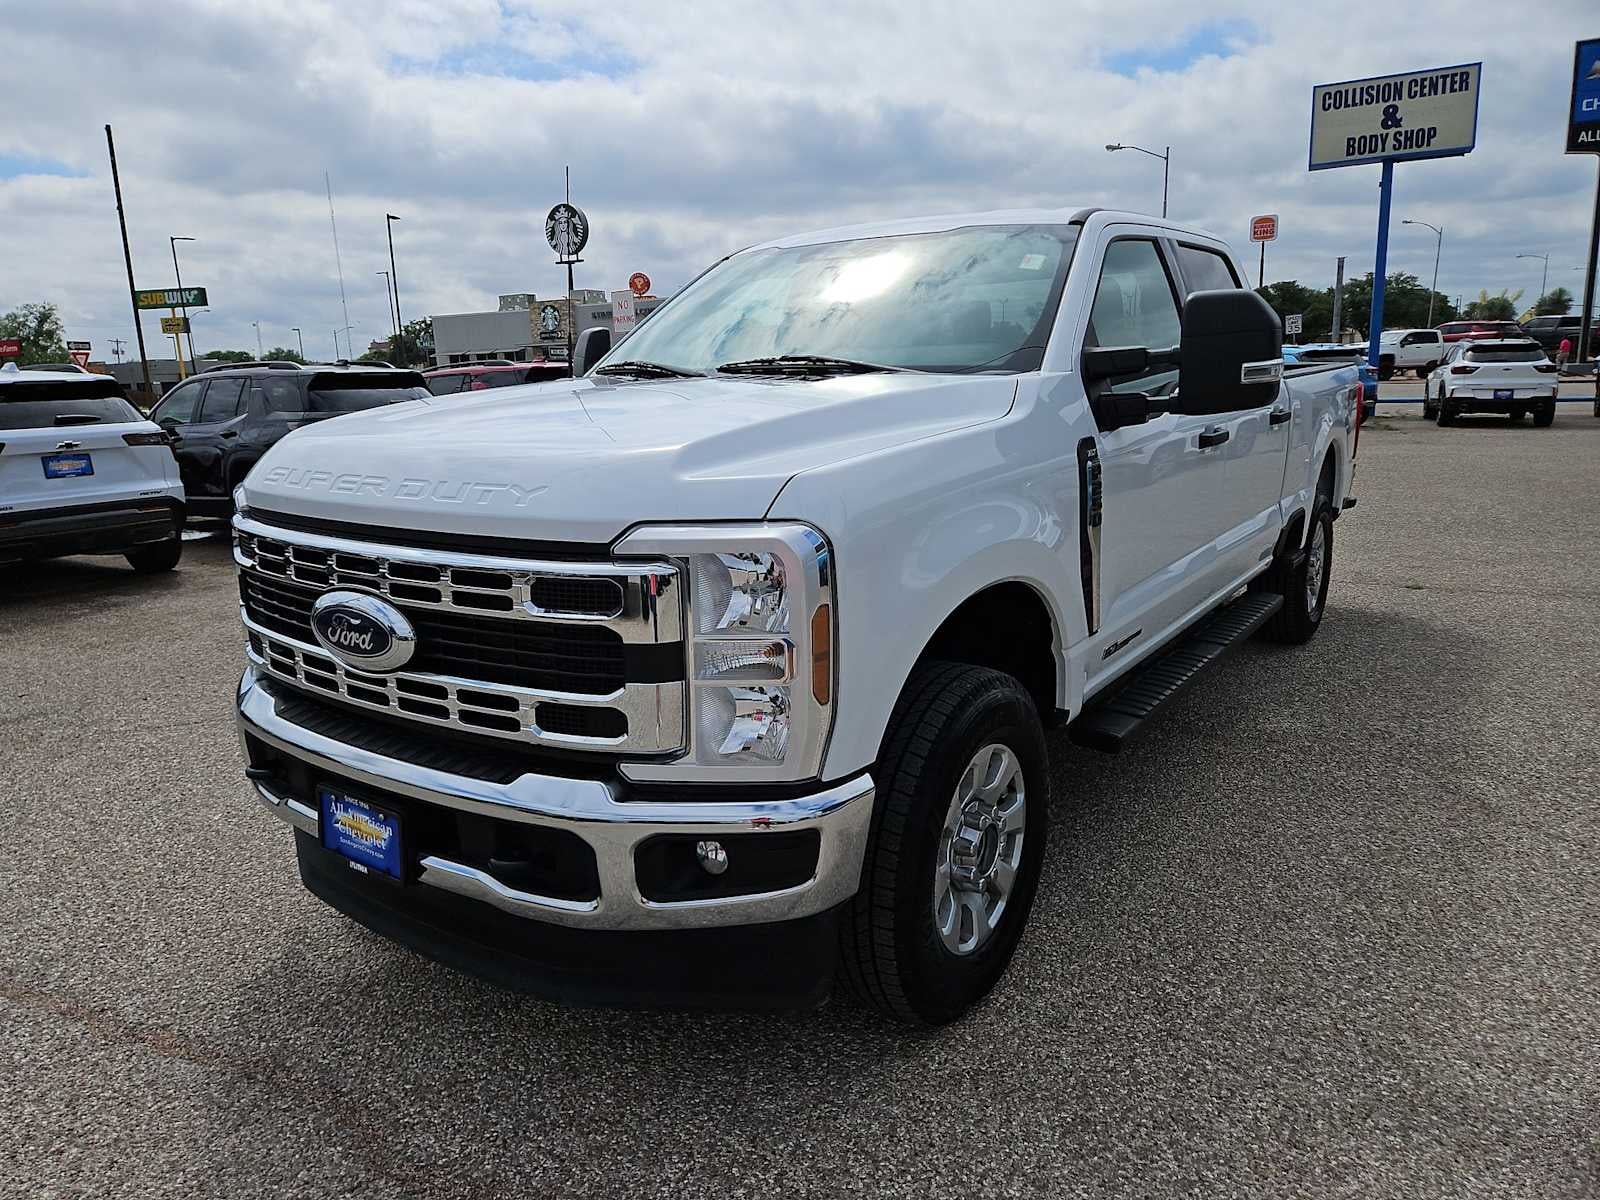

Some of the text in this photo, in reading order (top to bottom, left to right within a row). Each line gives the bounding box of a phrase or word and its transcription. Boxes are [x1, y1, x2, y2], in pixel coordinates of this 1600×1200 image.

[1321, 71, 1470, 111] COLLISION CENTER
[1380, 104, 1403, 130] &
[1345, 126, 1438, 157] BODY SHOP
[1253, 228, 1276, 236] KING
[138, 290, 199, 305] SUBWAY
[617, 300, 629, 310] NO
[1287, 325, 1301, 333] 35
[264, 466, 550, 507] SUPER DUTY
[327, 612, 375, 650] Ford
[338, 820, 386, 849] Chevrolet
[348, 808, 392, 836] American
